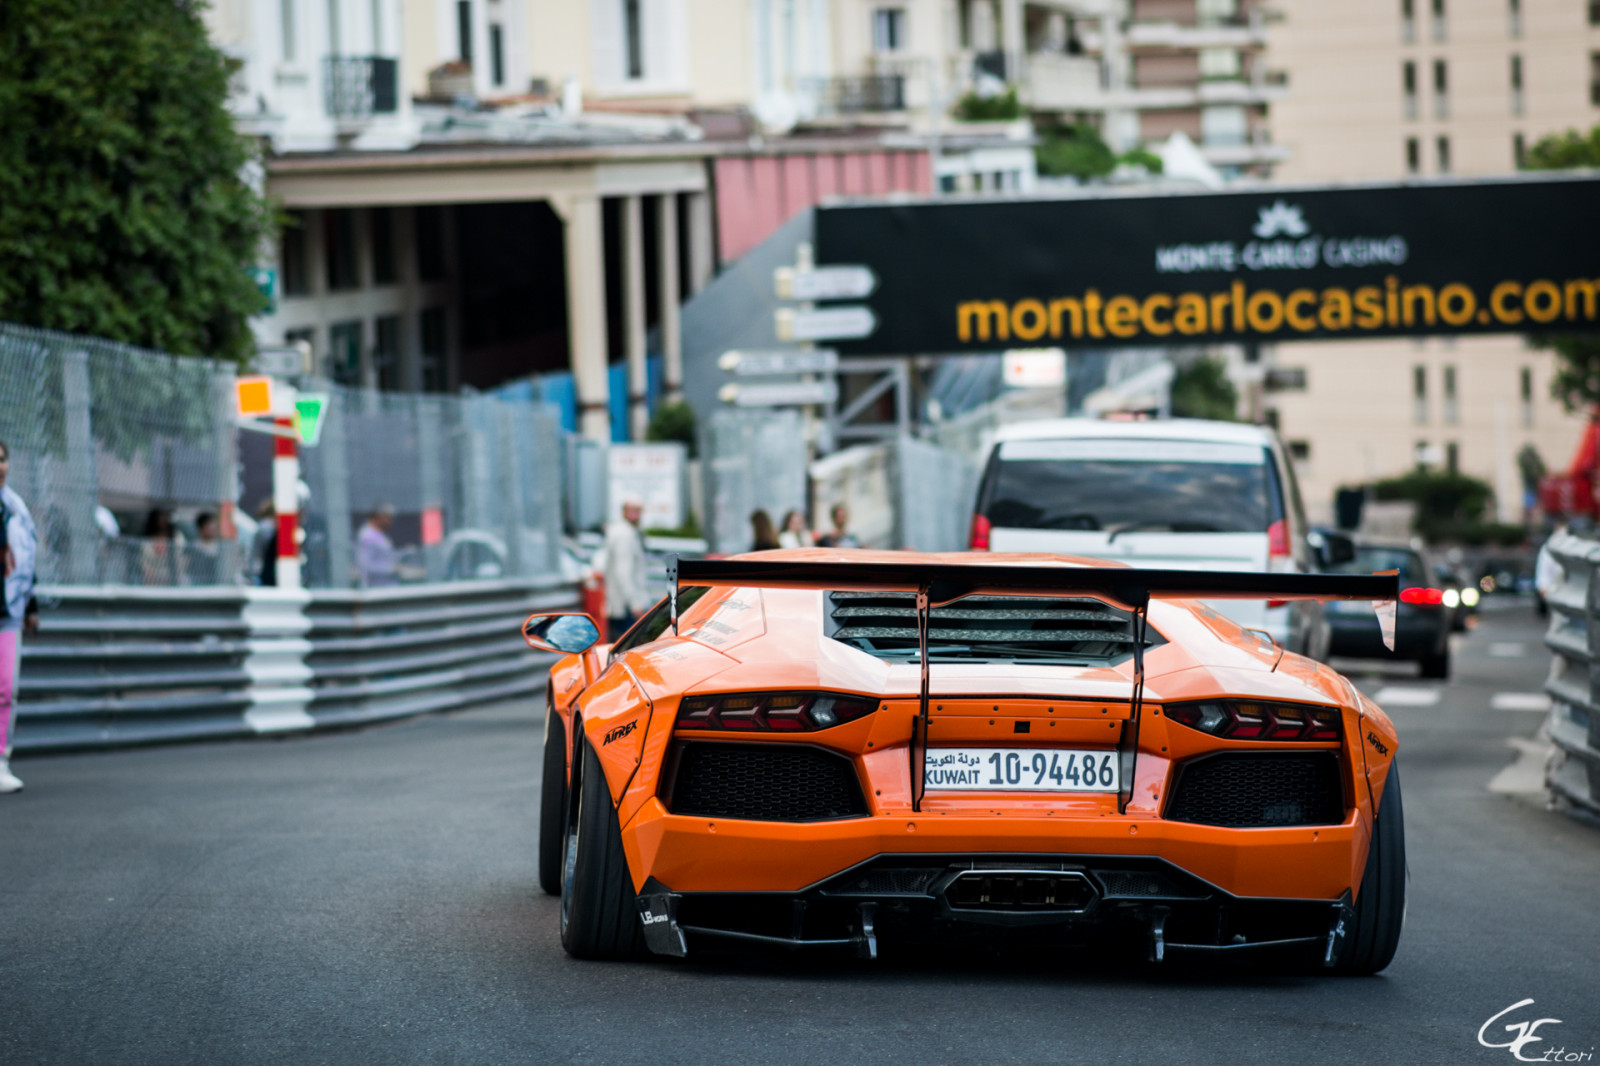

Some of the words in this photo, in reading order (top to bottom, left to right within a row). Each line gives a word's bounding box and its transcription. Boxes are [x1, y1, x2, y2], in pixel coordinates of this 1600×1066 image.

[1322, 235, 1408, 268] CASINO
[957, 274, 1600, 342] montecarlocasino.com
[957, 752, 980, 767] دولة
[988, 752, 1114, 787] 10-94486
[925, 769, 980, 785] KUWAIT
